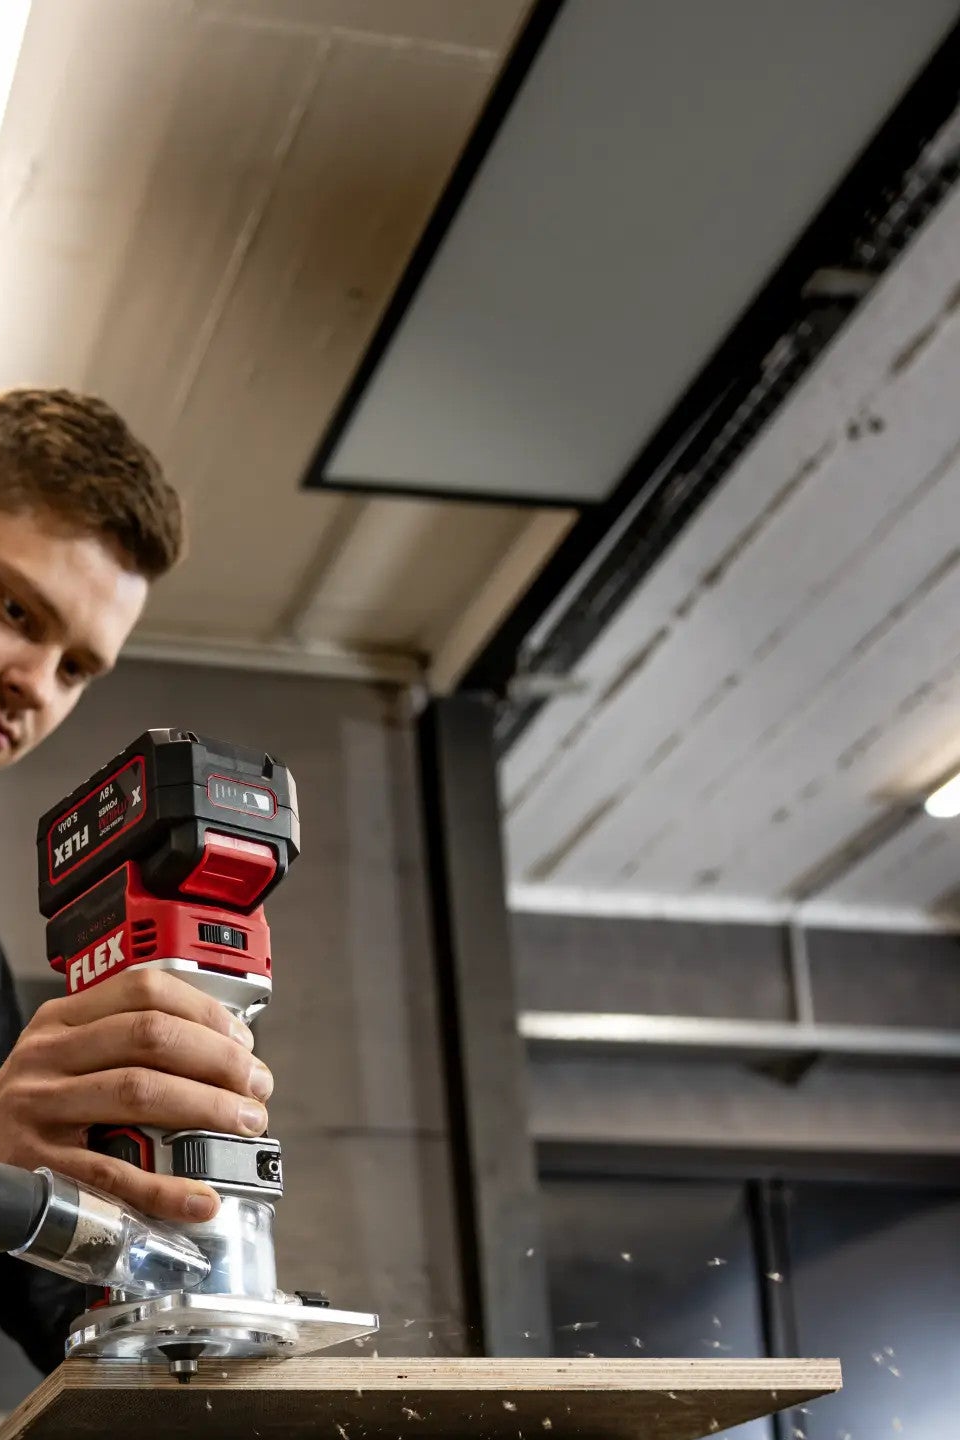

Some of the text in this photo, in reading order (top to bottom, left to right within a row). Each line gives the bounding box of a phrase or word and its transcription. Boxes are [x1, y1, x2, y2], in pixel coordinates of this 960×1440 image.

[100, 784, 113, 802] 18V
[99, 797, 117, 817] POWER
[58, 812, 78, 833] 5.0Ah
[54, 825, 88, 868] FLEX
[223, 931, 230, 941] 6
[70, 930, 125, 993] FLEX
